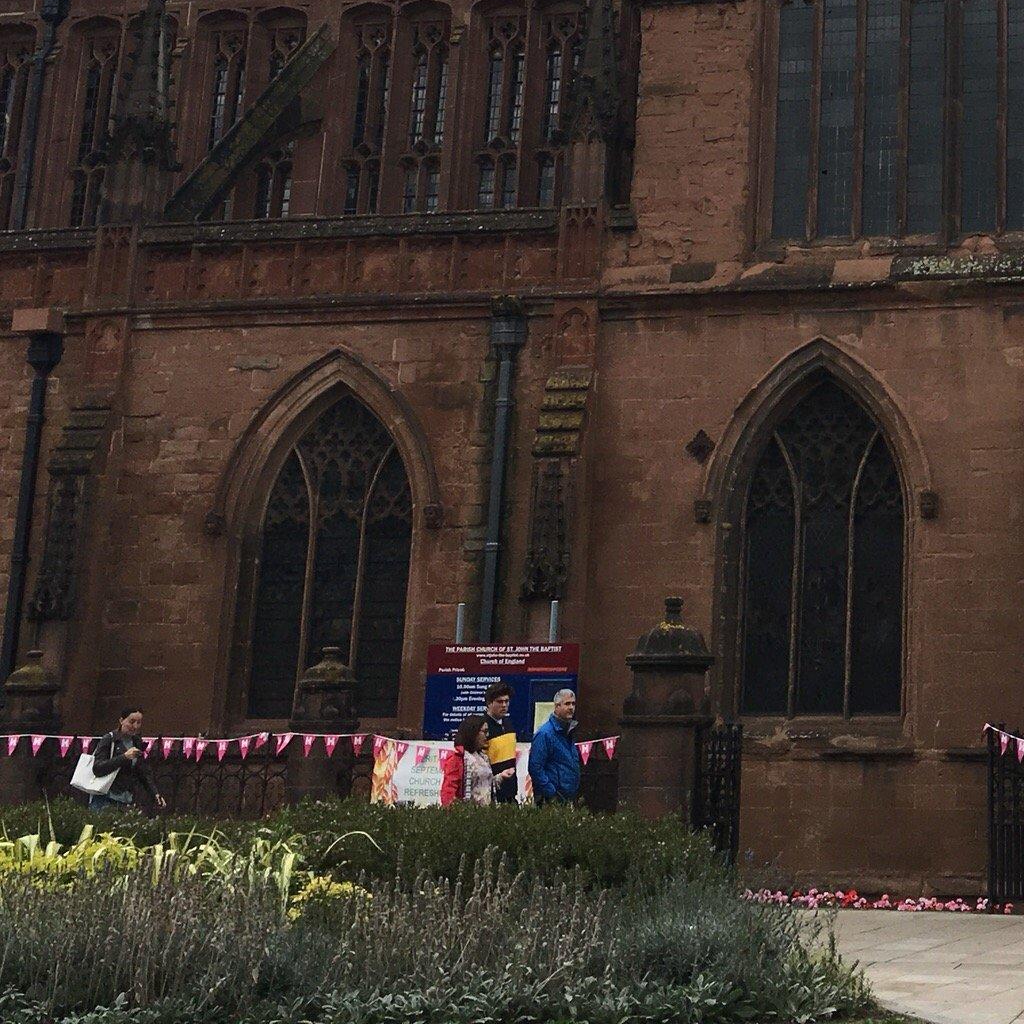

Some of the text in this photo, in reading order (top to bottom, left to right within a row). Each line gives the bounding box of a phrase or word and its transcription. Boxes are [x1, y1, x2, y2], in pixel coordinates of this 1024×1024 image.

[445, 646, 456, 654] THE
[456, 646, 476, 654] PARISH
[476, 646, 498, 654] CHURCH
[529, 645, 540, 653] THE
[540, 645, 562, 653] BAPTIST
